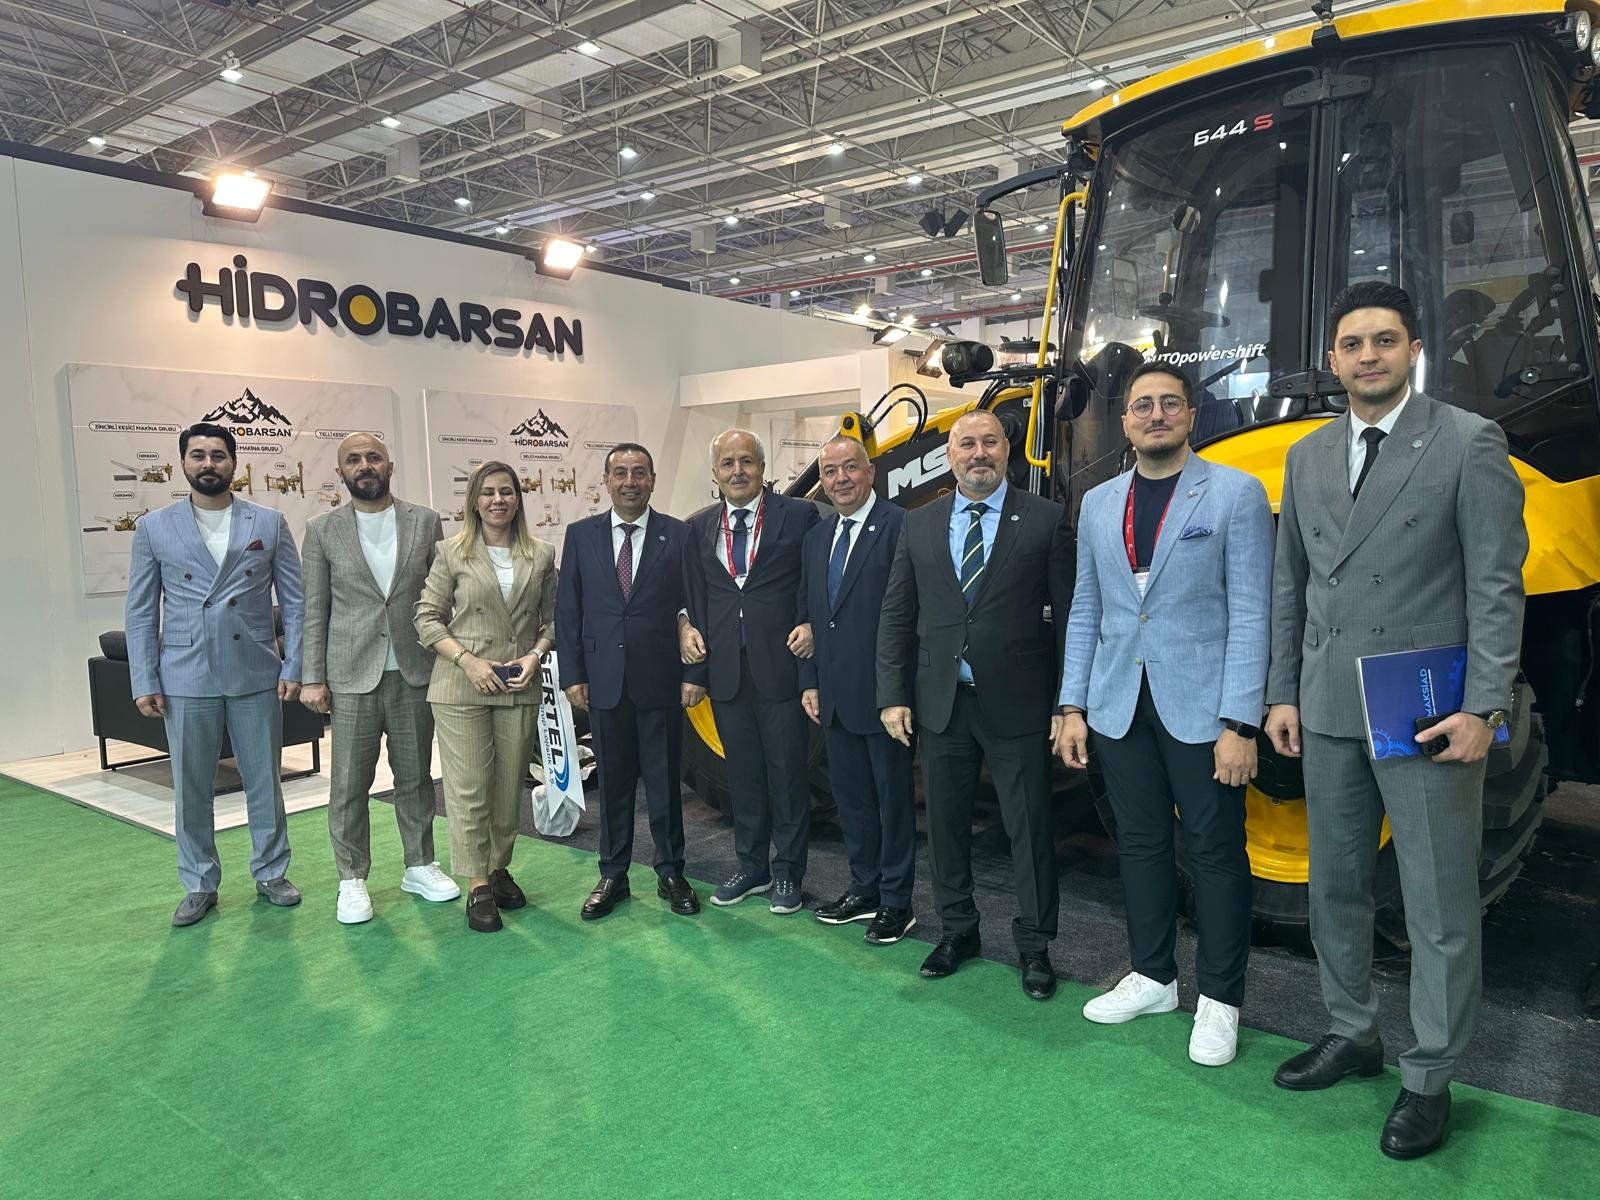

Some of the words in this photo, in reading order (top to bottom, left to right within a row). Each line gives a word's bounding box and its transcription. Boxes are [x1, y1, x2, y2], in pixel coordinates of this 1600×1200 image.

[1193, 119, 1249, 147] 644
[1252, 113, 1274, 132] S
[540, 650, 564, 765] SERTEL
